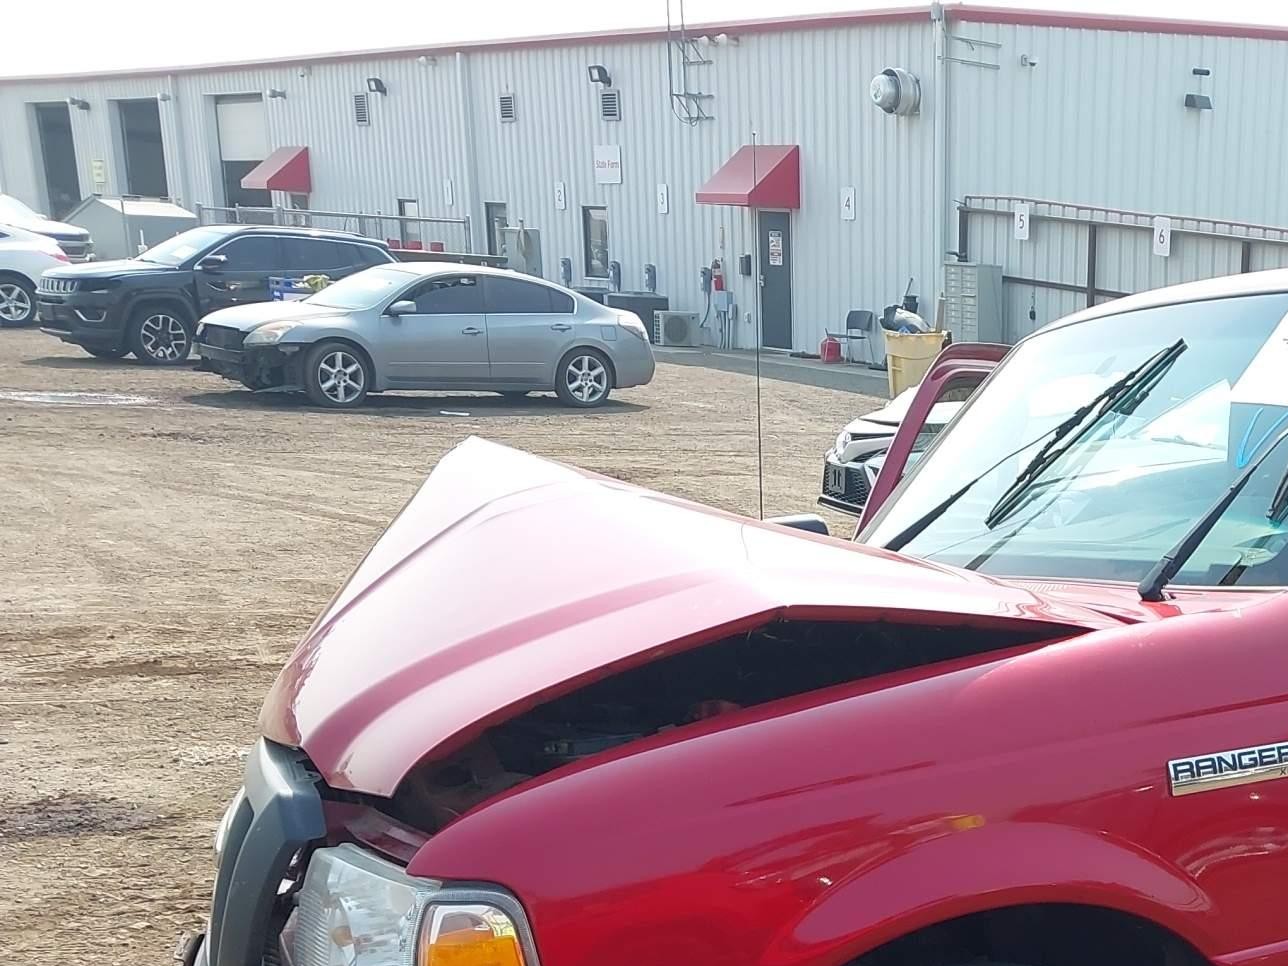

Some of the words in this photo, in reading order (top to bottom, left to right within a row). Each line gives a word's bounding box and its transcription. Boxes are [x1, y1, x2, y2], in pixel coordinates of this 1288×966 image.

[595, 159, 607, 169] State
[556, 189, 562, 201] 2
[659, 192, 664, 205] 3
[844, 196, 851, 210] 4
[1018, 213, 1025, 230] 5
[1158, 227, 1165, 245] 6
